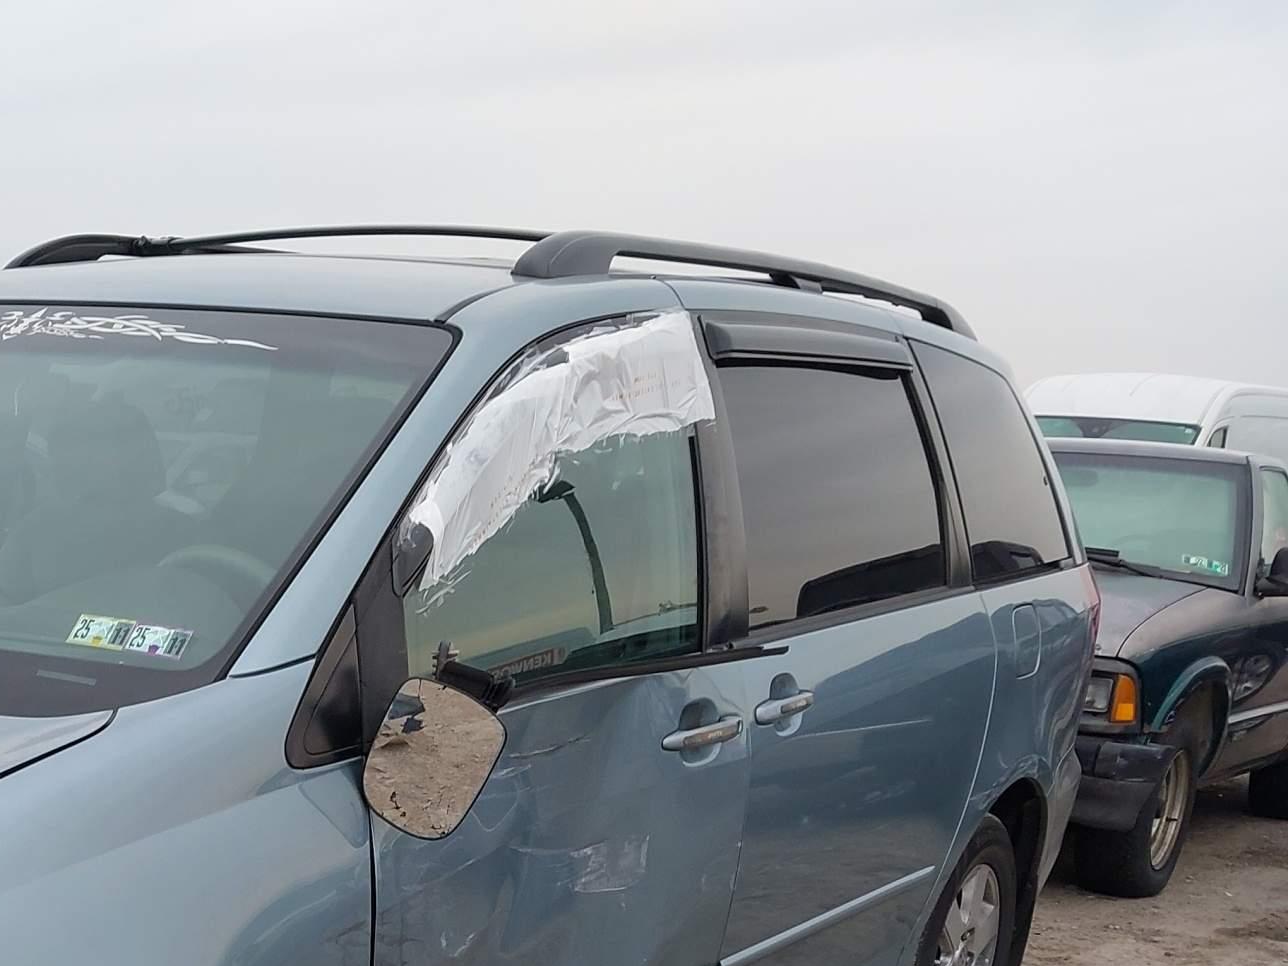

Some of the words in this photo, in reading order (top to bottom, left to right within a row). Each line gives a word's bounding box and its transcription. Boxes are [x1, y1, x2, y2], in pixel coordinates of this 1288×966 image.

[73, 618, 95, 640] 25
[110, 626, 130, 646] 11
[129, 626, 151, 649] 25
[167, 635, 187, 656] 11
